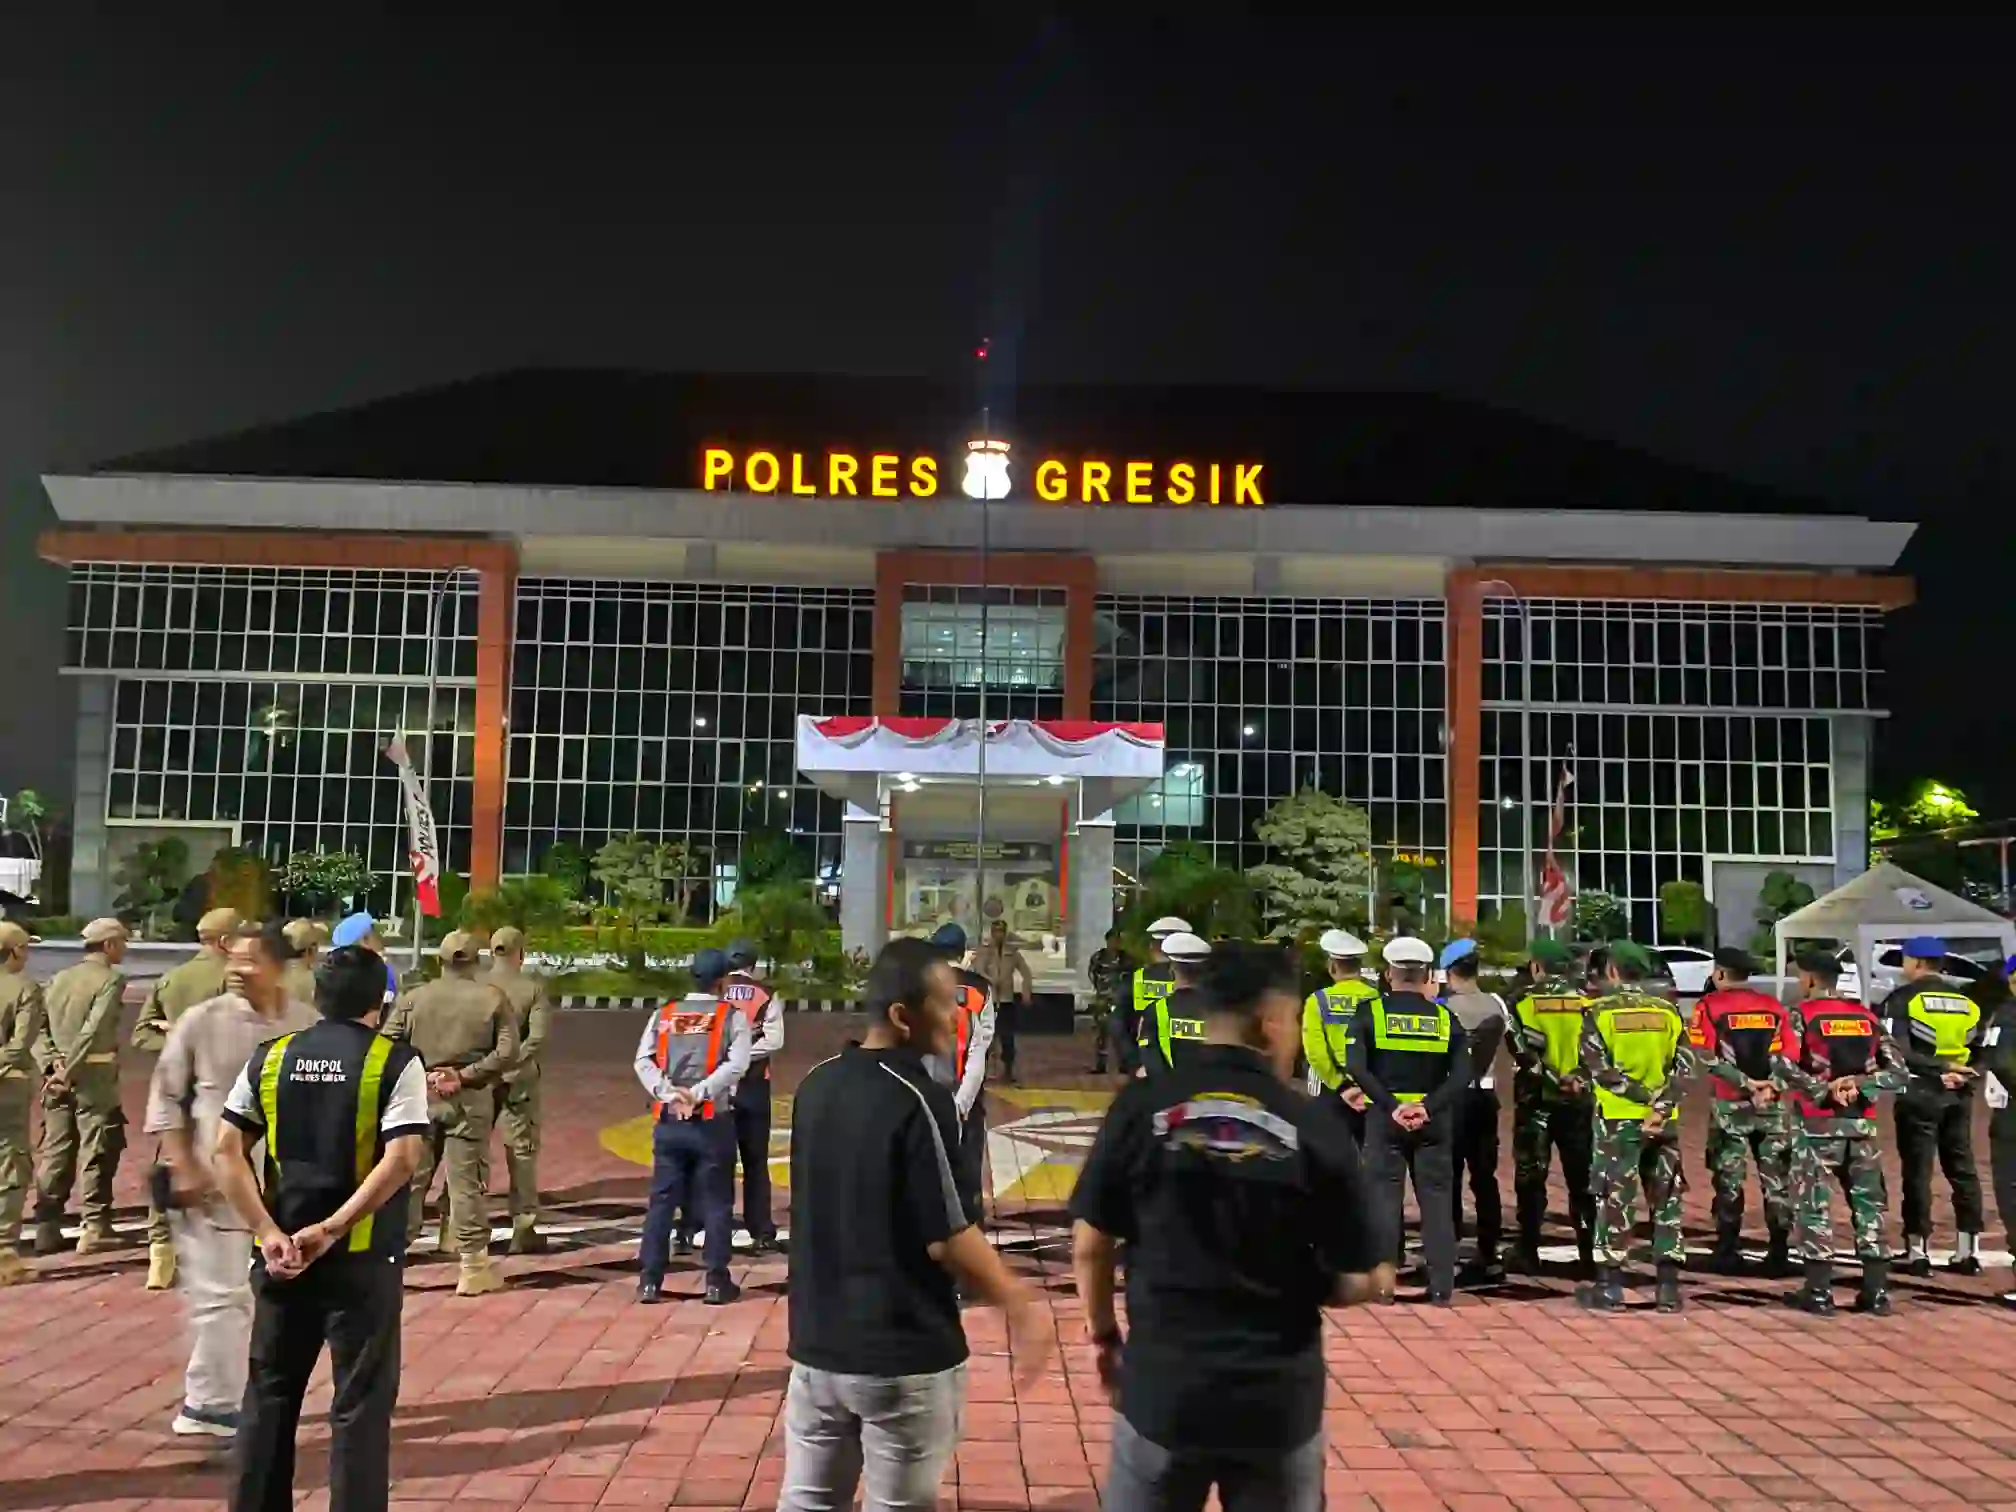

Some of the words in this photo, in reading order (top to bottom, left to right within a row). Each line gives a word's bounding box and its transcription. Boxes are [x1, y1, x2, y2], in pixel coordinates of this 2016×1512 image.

[704, 449, 938, 497] POLRES
[1036, 460, 1264, 505] GRESIK
[295, 1058, 343, 1073] DOKPOL
